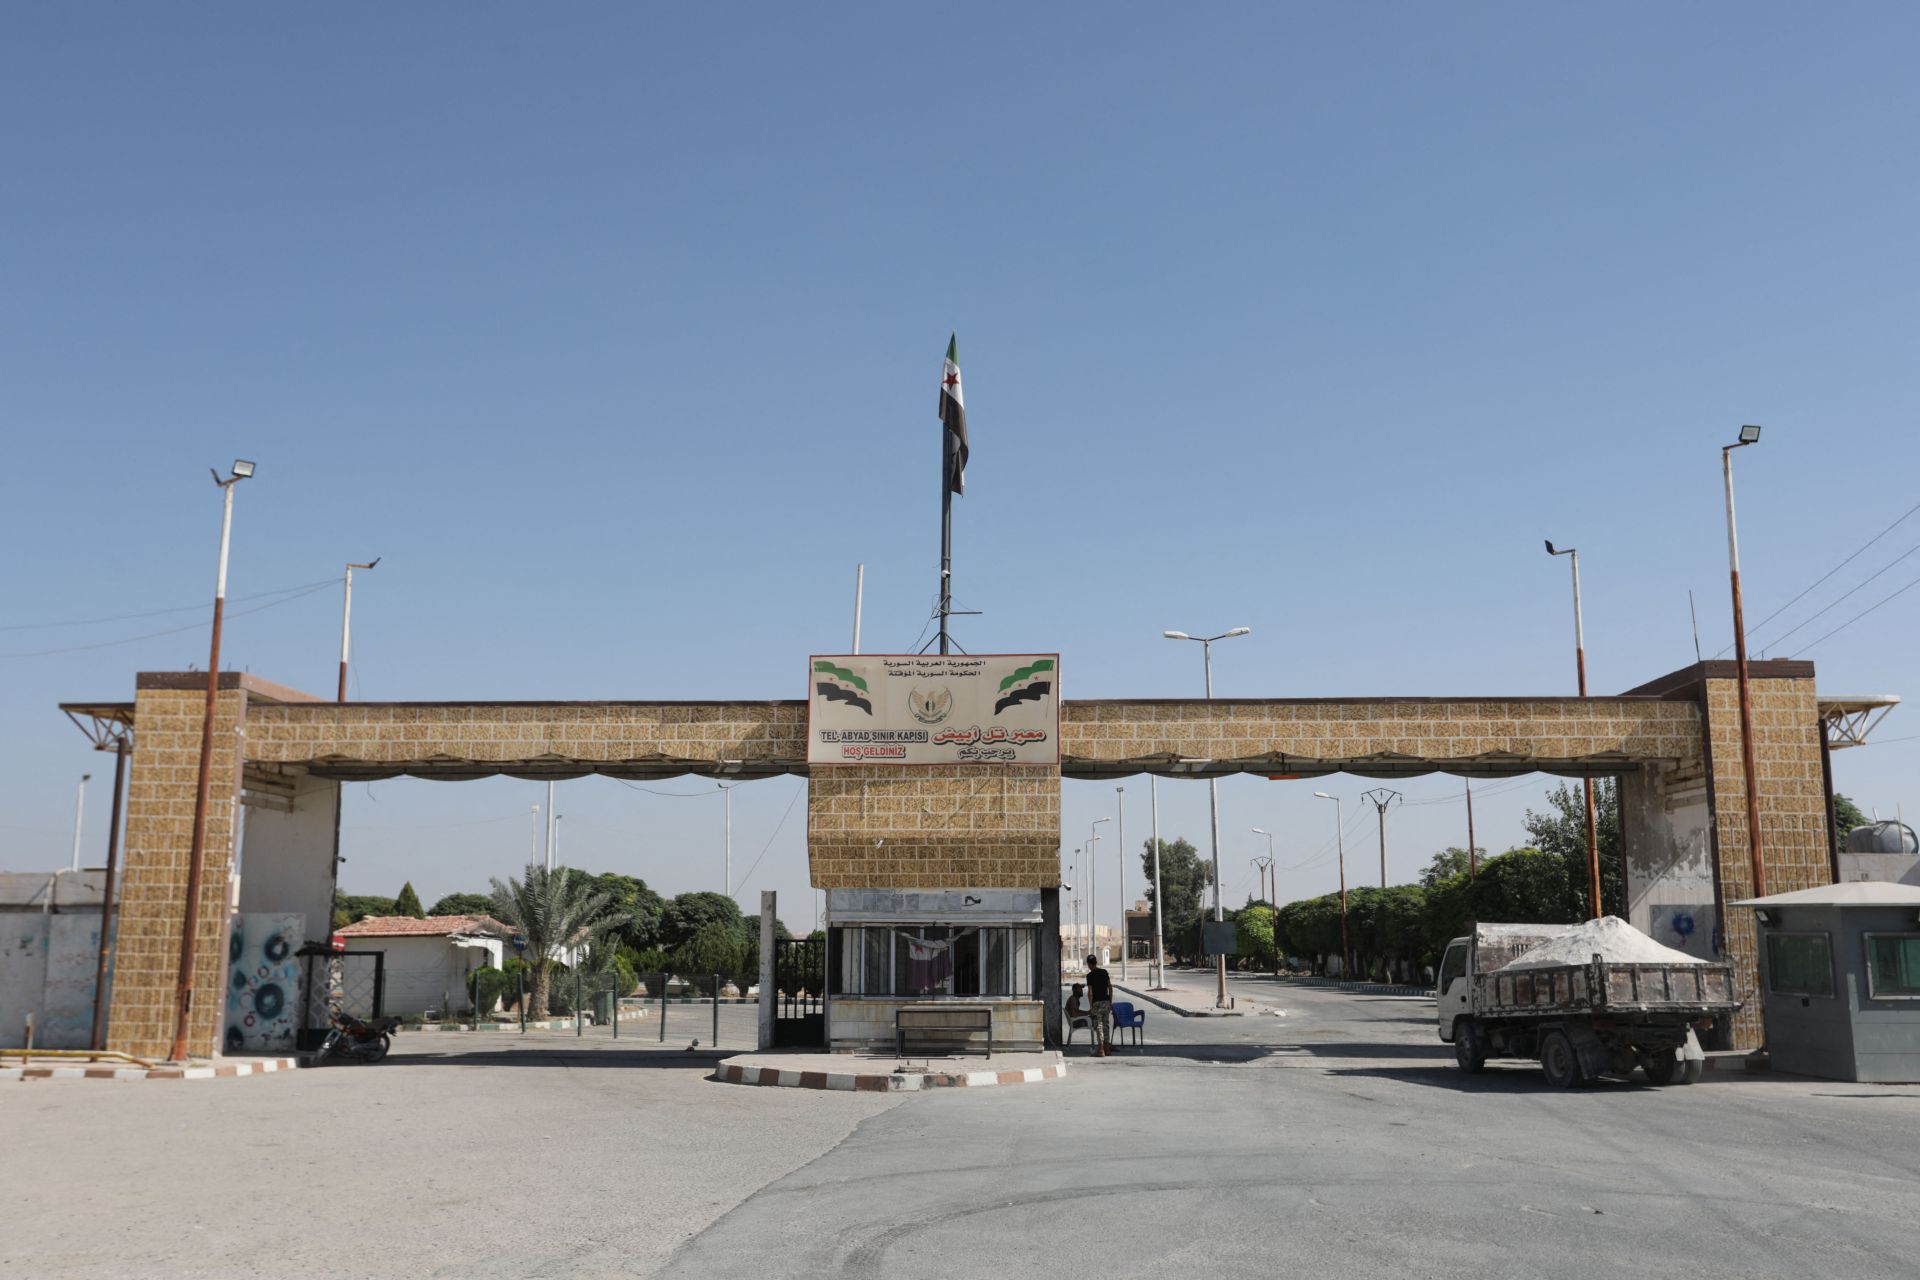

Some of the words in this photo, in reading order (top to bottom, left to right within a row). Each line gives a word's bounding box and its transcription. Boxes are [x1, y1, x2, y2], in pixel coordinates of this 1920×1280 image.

[883, 660, 914, 668] السورية
[916, 660, 945, 668] العربية
[947, 660, 986, 668] الجمهورية
[842, 730, 870, 741] ABYAD
[872, 730, 896, 741] SINIR
[897, 730, 926, 741] KAPISI
[980, 728, 1006, 742] تل
[1009, 728, 1044, 744] معبر
[842, 746, 862, 758] HOŞ
[862, 744, 904, 757] GELDİNİZ
[959, 746, 980, 758] بكم
[981, 748, 1014, 758] يرحب
